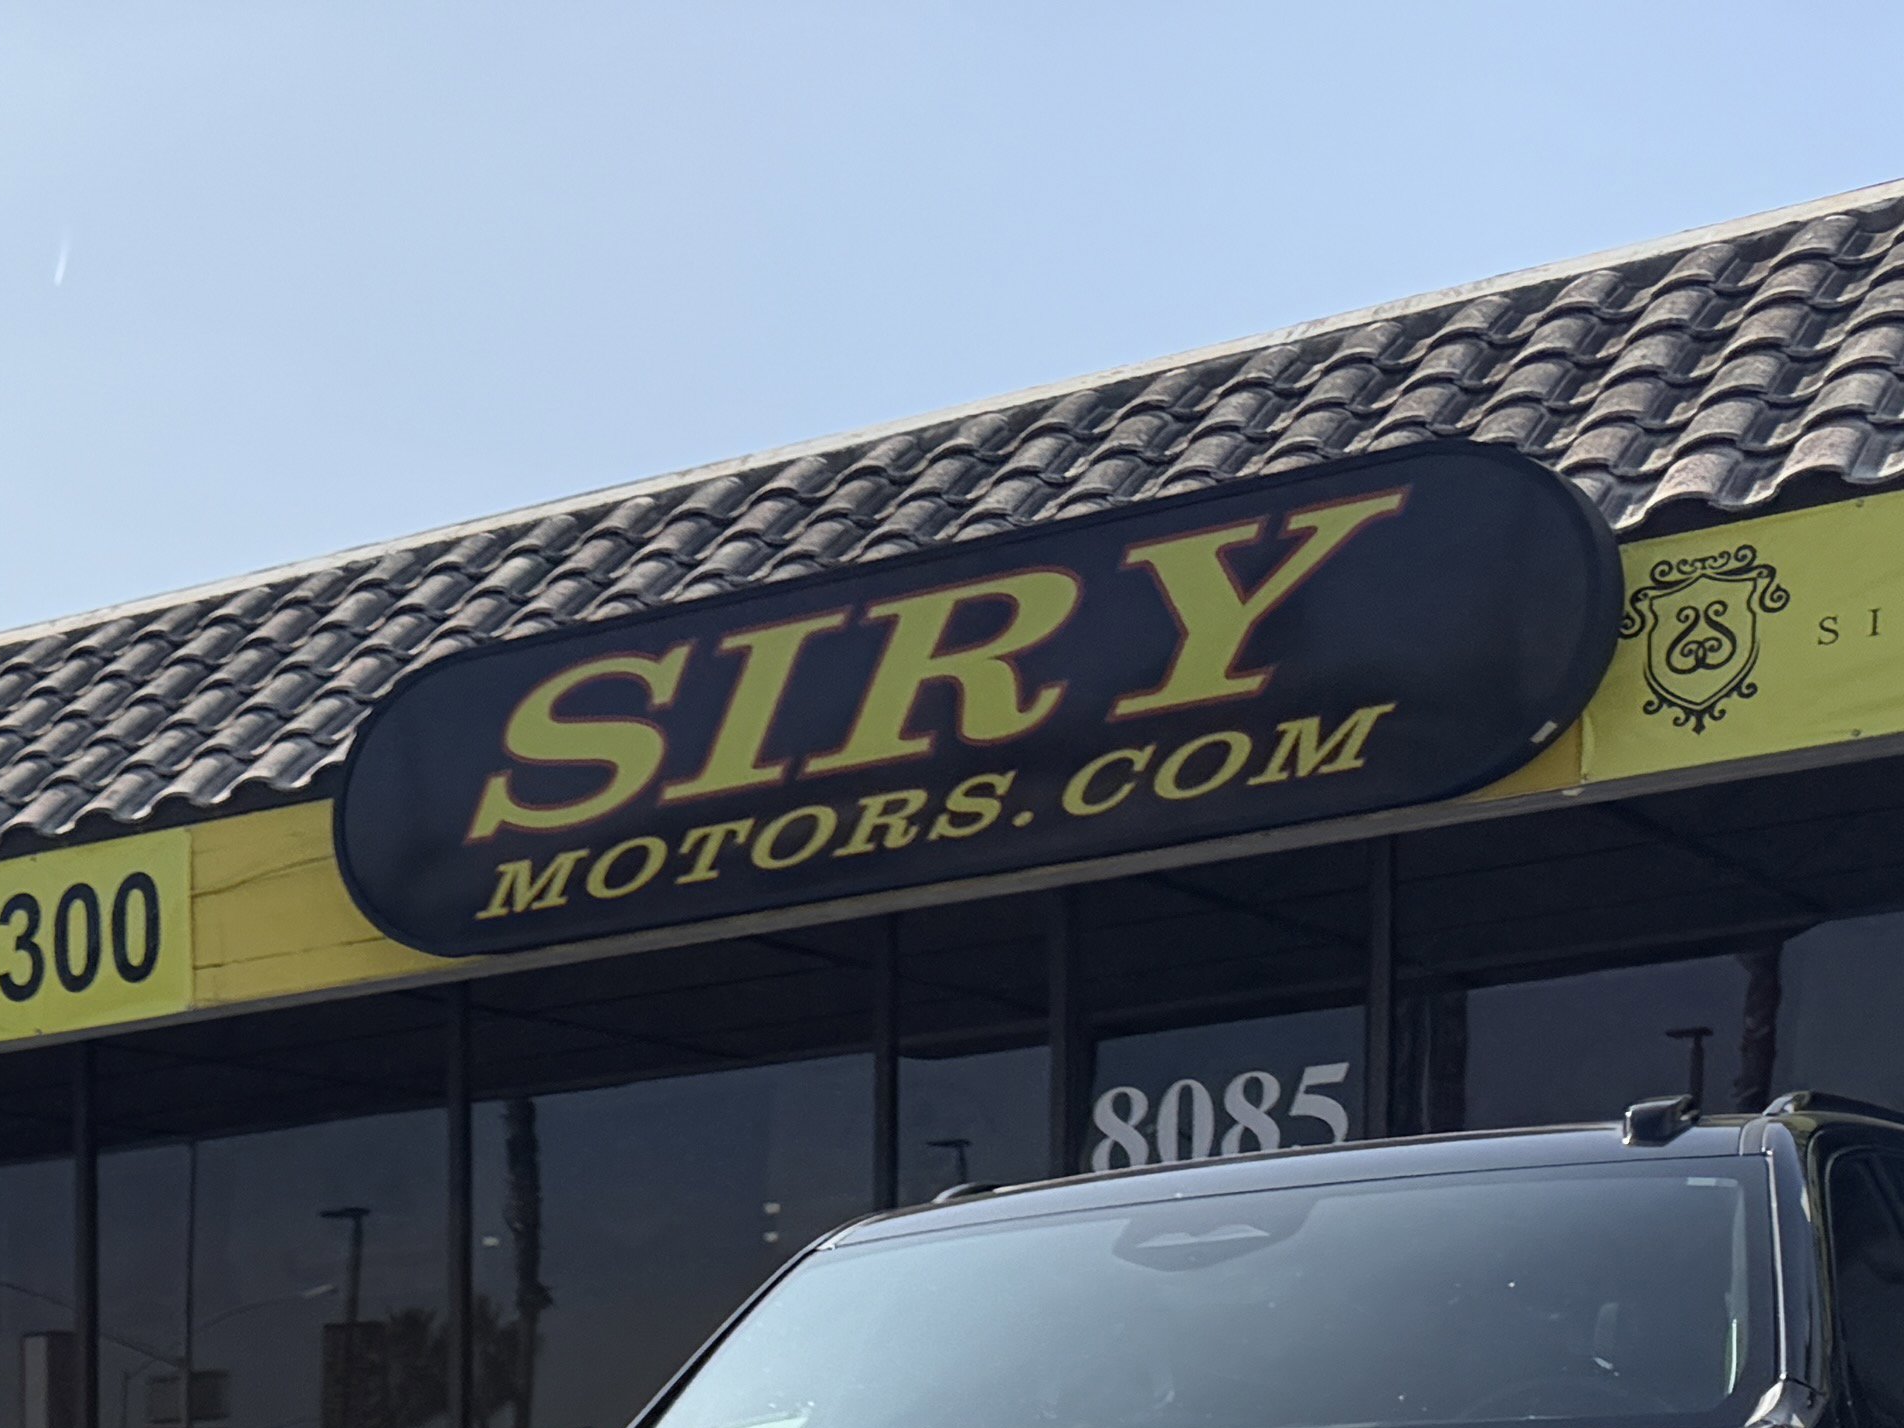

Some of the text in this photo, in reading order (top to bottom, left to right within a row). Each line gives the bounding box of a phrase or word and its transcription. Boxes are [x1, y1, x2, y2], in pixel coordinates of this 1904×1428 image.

[466, 488, 1409, 842] SIRY
[476, 702, 1399, 921] MOTORS.COM
[1091, 1062, 1351, 1172] 8085
